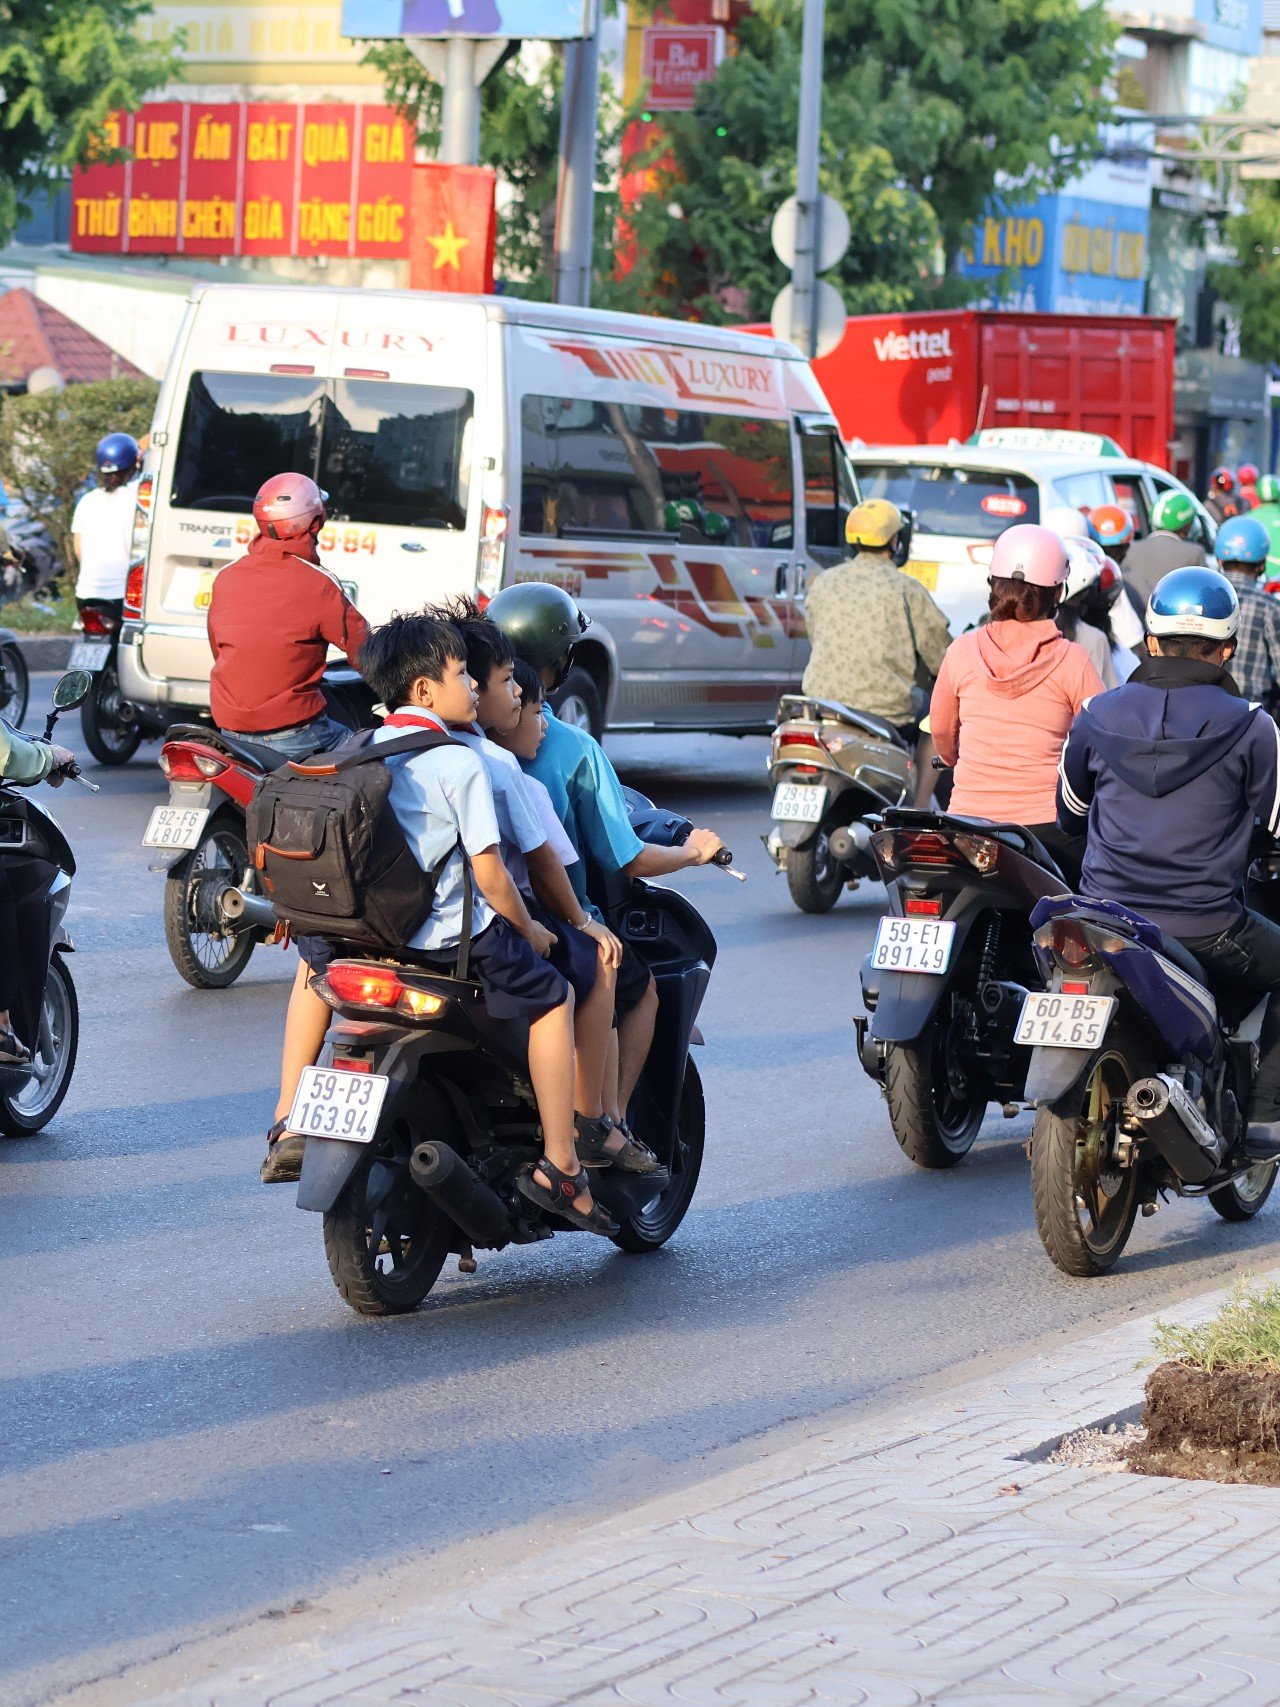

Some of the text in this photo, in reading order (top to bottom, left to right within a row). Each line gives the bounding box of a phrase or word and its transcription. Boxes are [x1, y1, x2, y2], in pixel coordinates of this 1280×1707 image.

[364, 118, 406, 163] GIÁ
[357, 195, 405, 243] GỐC
[982, 216, 1045, 268] KHO
[227, 325, 444, 352] LUXURY
[873, 327, 954, 363] viettel
[687, 358, 771, 393] LUXURY
[178, 522, 233, 536] TRANSIT
[783, 786, 818, 801] 29-L5
[158, 810, 199, 827] 92-F6
[152, 828, 192, 844] 4807
[889, 921, 940, 945] 59-E1
[877, 944, 945, 969] 891.49
[1036, 997, 1098, 1021] 60-B5
[1021, 1020, 1100, 1044] 314.65
[310, 1073, 374, 1106] 59-P3
[299, 1102, 368, 1137] 163.94
